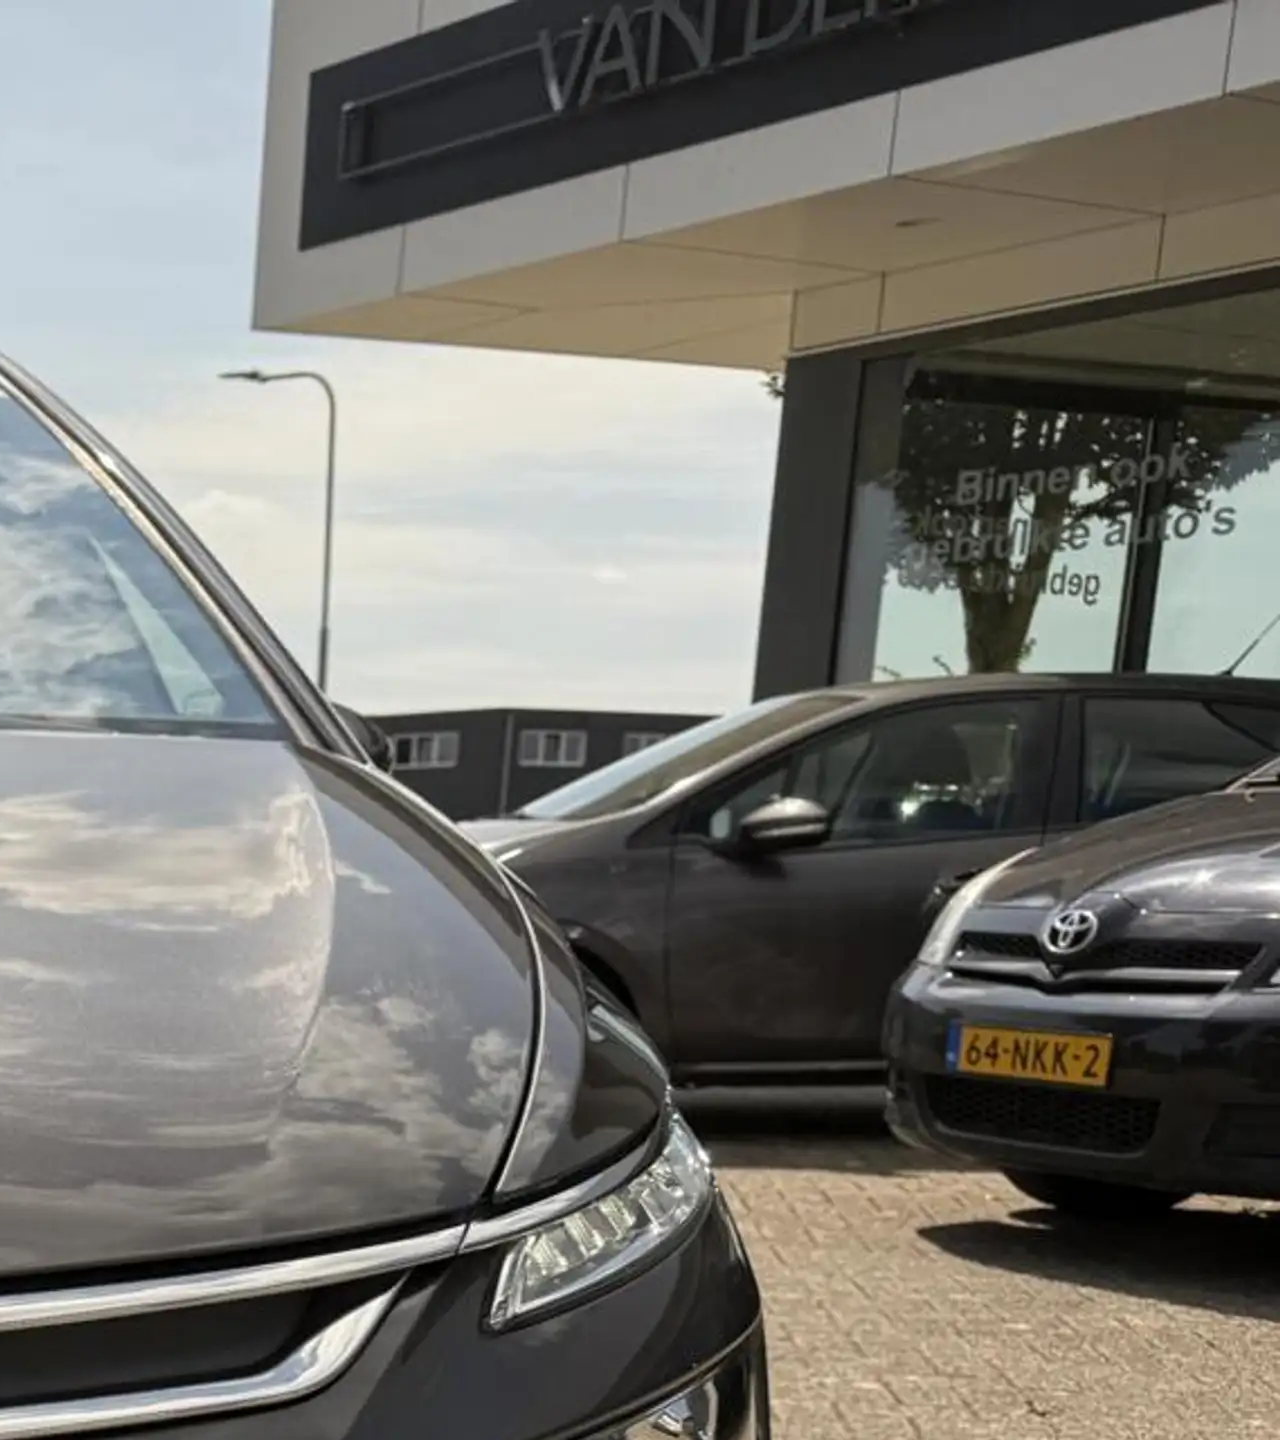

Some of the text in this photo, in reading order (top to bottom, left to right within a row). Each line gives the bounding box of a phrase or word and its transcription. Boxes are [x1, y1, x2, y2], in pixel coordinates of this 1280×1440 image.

[540, 0, 716, 112] VAN
[954, 444, 1191, 506] Binnen ook
[1104, 499, 1237, 548] auto's
[966, 1032, 1100, 1078] 64-NKK-2
